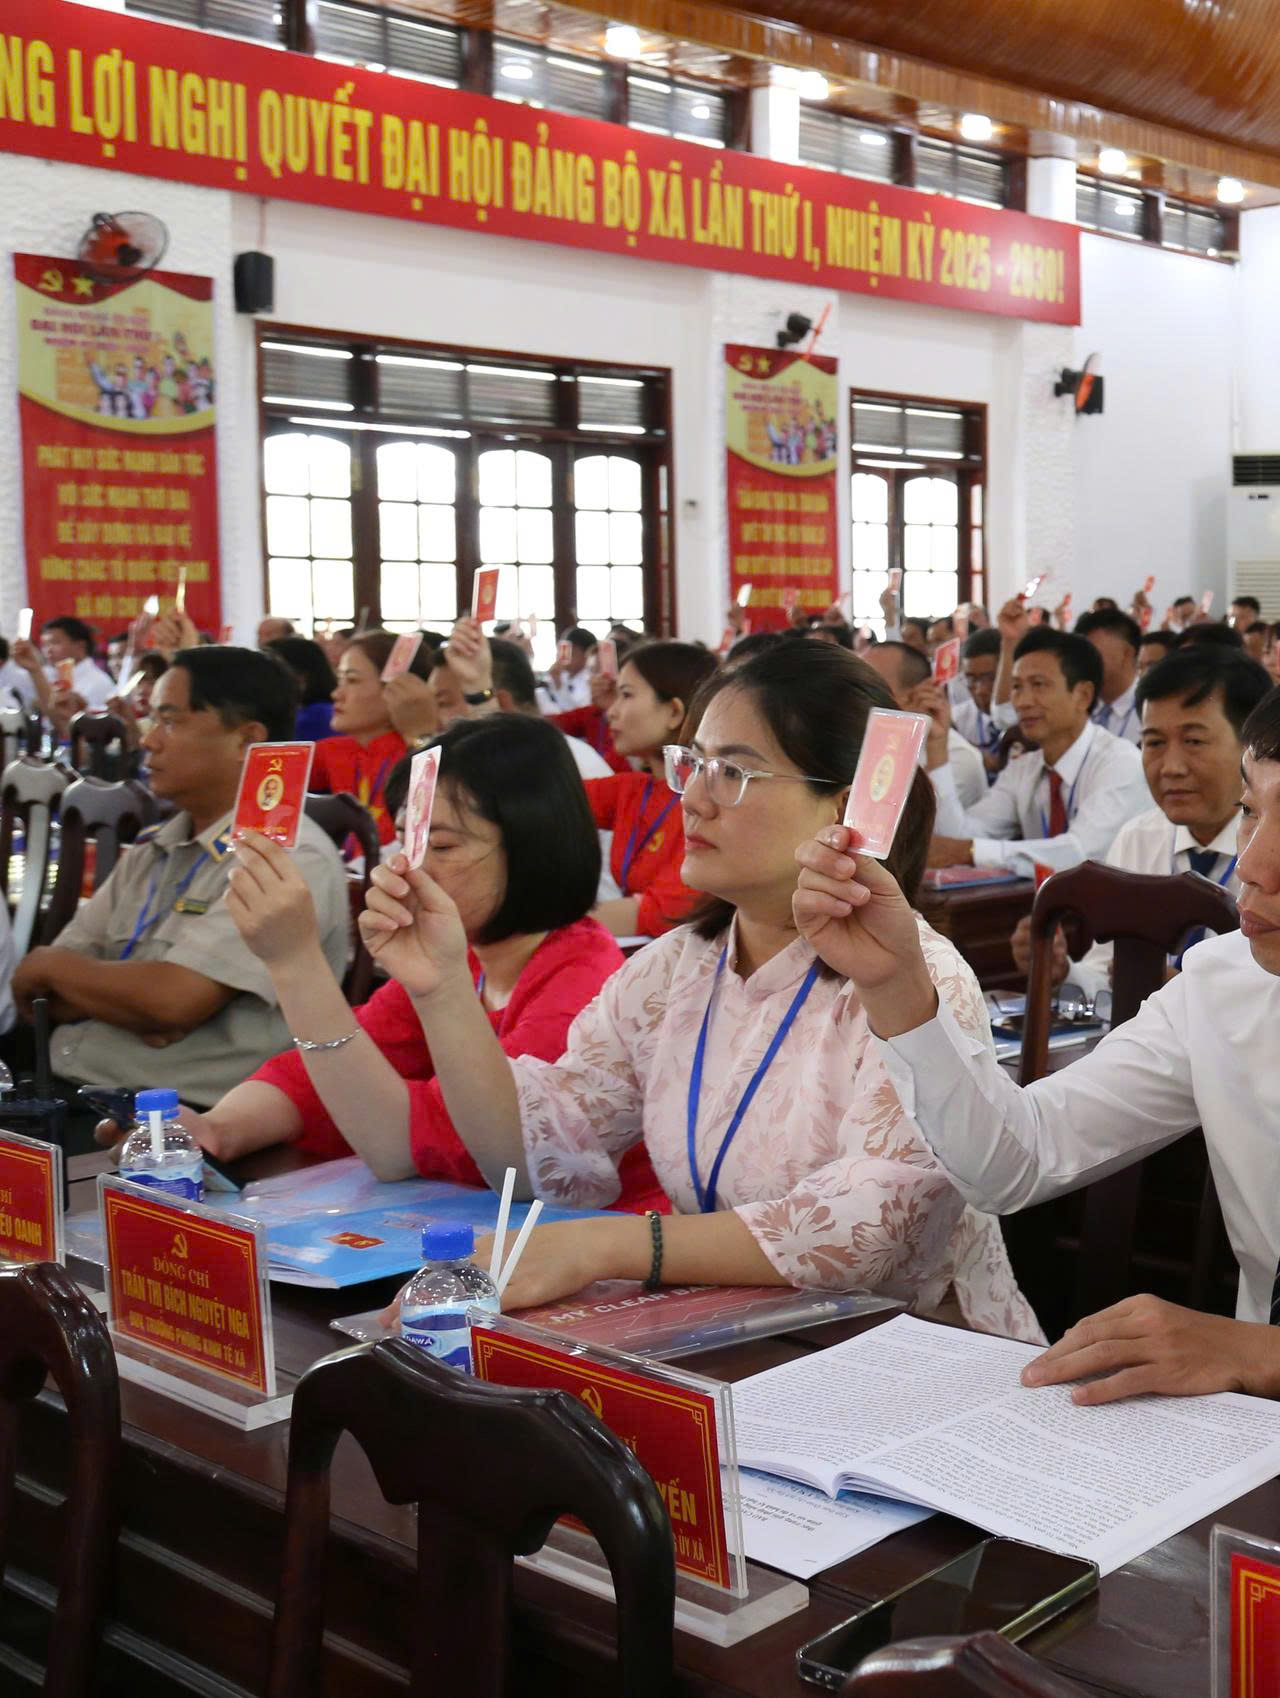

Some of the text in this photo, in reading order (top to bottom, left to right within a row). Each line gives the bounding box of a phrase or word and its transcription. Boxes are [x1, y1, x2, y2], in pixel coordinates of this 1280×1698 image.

[69, 48, 138, 158] LỢI
[149, 66, 249, 181] NGHỊ
[259, 81, 375, 185] QUYẾT
[381, 114, 442, 211] ĐẠI
[449, 119, 506, 222] HỘI
[511, 122, 597, 225] ĐẢNG
[602, 150, 642, 247] BỘ
[648, 160, 688, 242] XÃ
[692, 159, 745, 250] LẦN
[750, 182, 801, 261] THỨ
[825, 200, 903, 287] NHIỆM
[907, 212, 938, 282] KỲ
[940, 229, 991, 293] 2025
[15, 1217, 42, 1247] OANH
[188, 1268, 210, 1289] CHÍ
[594, 1292, 670, 1313] CLEAR
[227, 1306, 250, 1339] NGA
